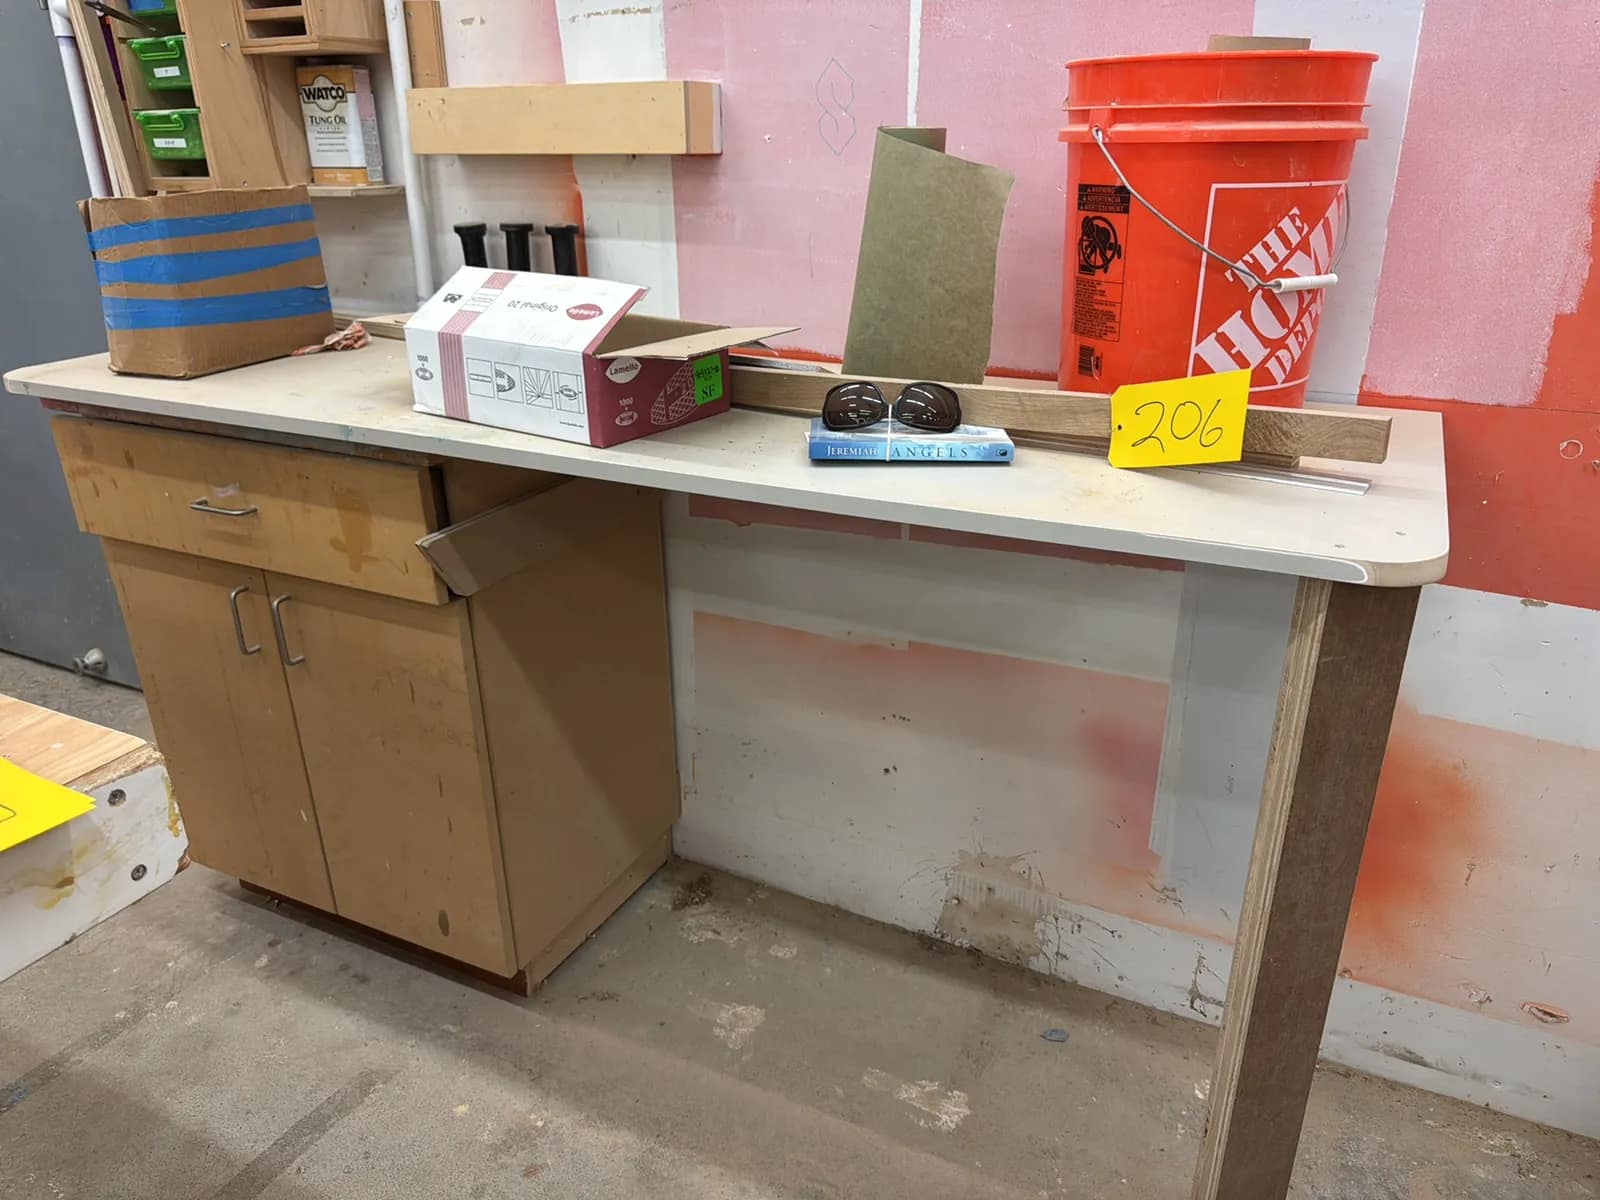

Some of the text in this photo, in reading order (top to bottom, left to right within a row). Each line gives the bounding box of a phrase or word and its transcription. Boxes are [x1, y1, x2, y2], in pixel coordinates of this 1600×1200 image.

[303, 86, 345, 100] WATCO
[309, 115, 333, 125] TUNG
[1224, 206, 1310, 293] THE
[507, 299, 559, 314] Original 20
[609, 360, 640, 376] Lamello
[1131, 398, 1224, 453] 206
[826, 444, 969, 458] JEREMIAH ANGELS
